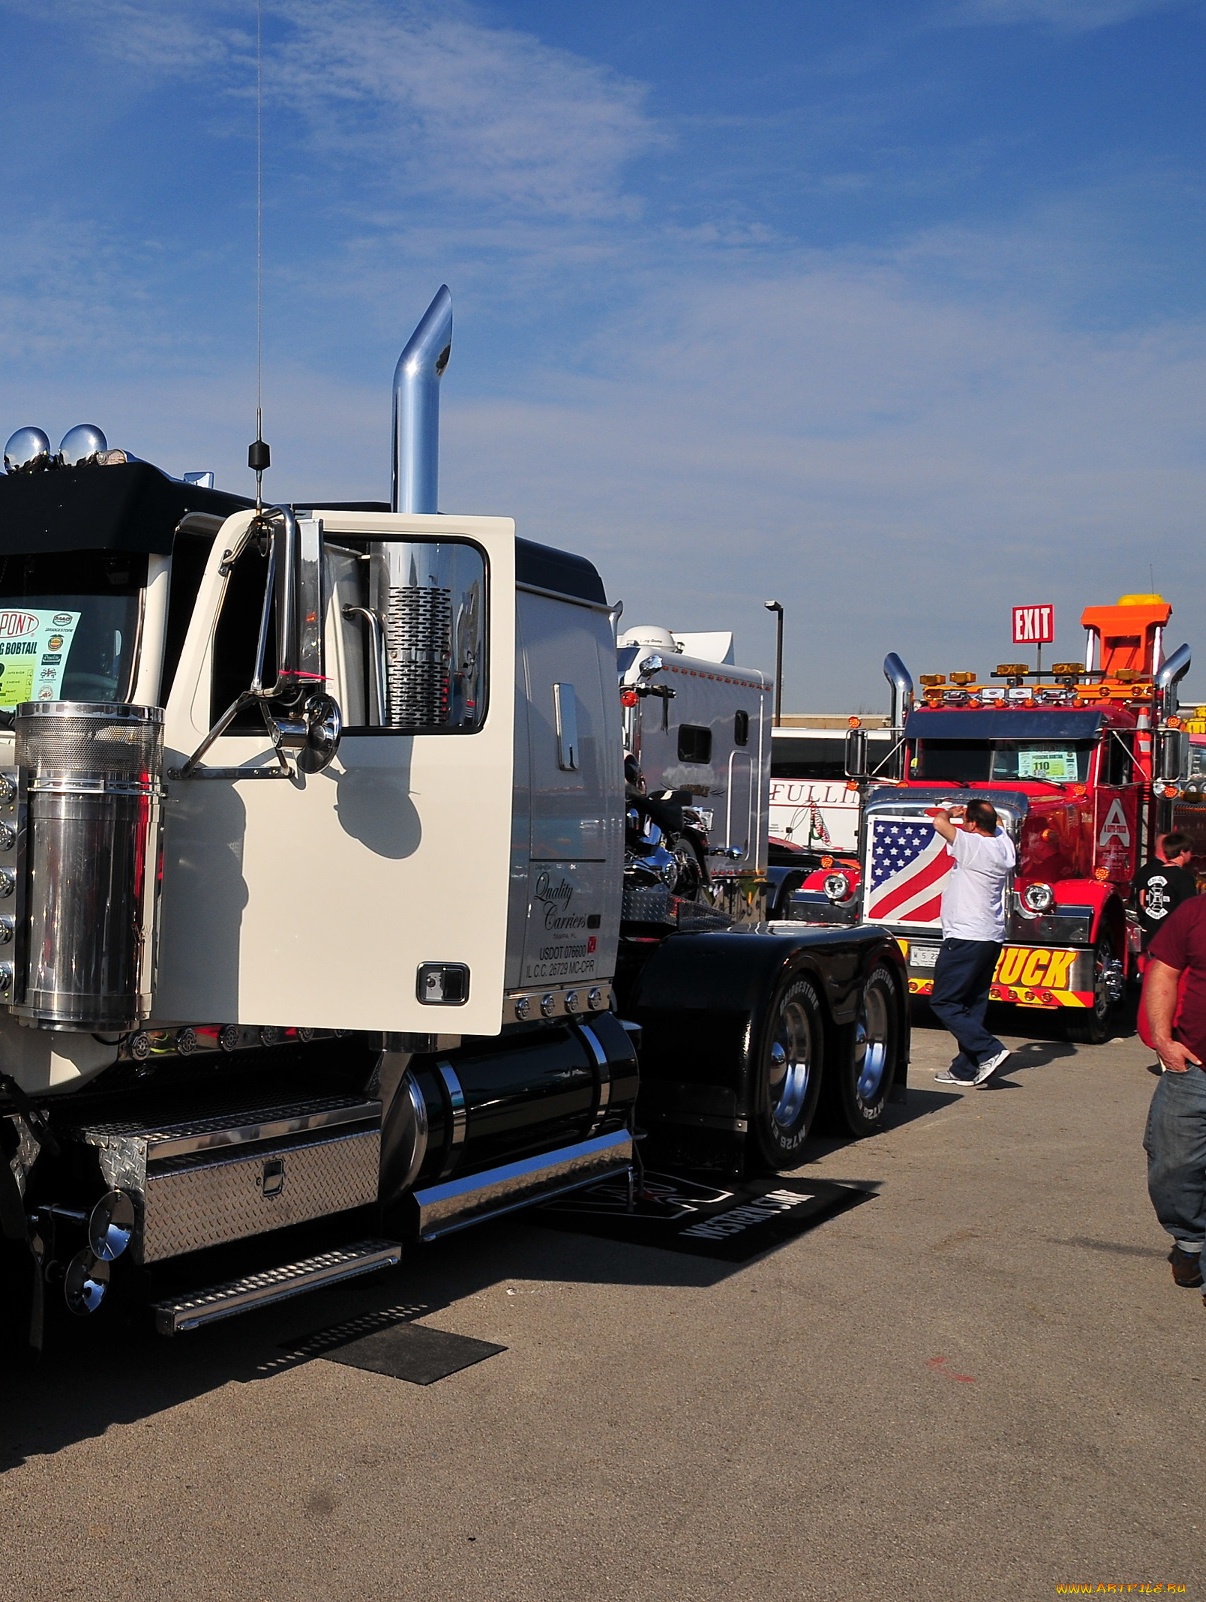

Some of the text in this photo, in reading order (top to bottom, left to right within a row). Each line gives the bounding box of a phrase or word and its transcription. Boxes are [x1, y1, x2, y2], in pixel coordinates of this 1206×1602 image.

[1015, 607, 1050, 640] EXIT
[5, 641, 38, 655] BOBTAIL
[1033, 761, 1050, 771] 110
[769, 783, 857, 804] FULLI
[534, 871, 573, 912] Quality
[540, 947, 564, 960] USDOT
[678, 1205, 782, 1240] WESTERN
